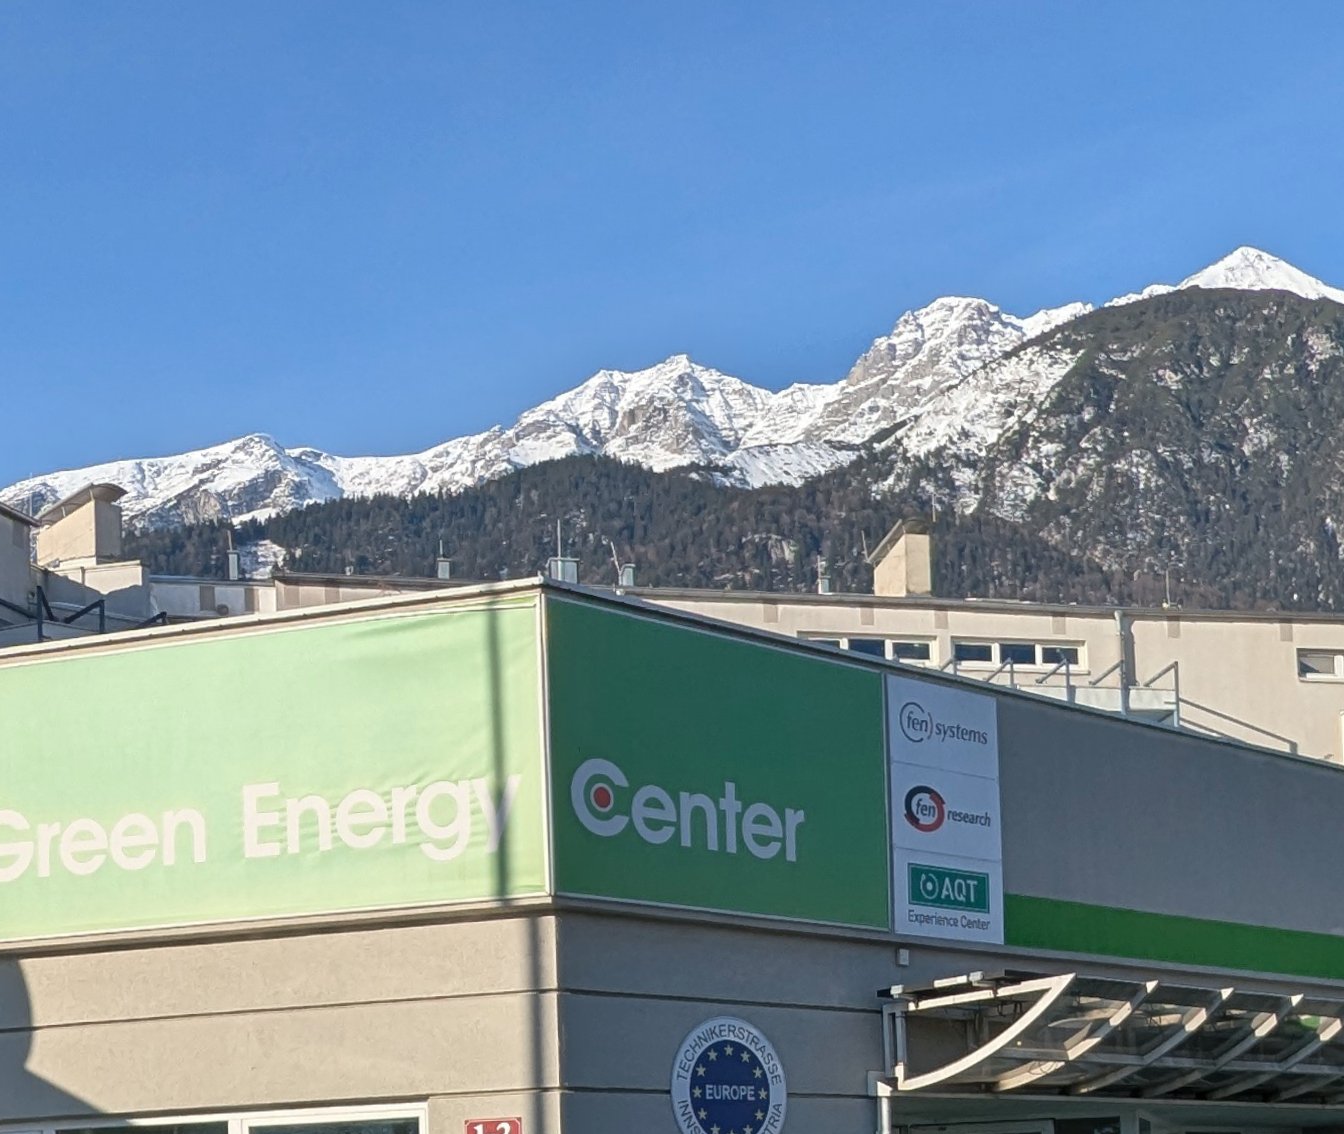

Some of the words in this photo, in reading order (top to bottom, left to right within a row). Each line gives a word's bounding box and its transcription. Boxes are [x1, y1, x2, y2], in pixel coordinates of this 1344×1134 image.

[934, 720, 988, 745] systems
[241, 772, 522, 862] Energy
[570, 758, 805, 862] Center
[947, 809, 991, 827] research
[940, 875, 978, 904] AQT
[908, 909, 959, 929] Experience
[960, 914, 991, 931] Center
[676, 1023, 782, 1086] TECHNIKERSTRASSE
[705, 1084, 756, 1101] EUROPE
